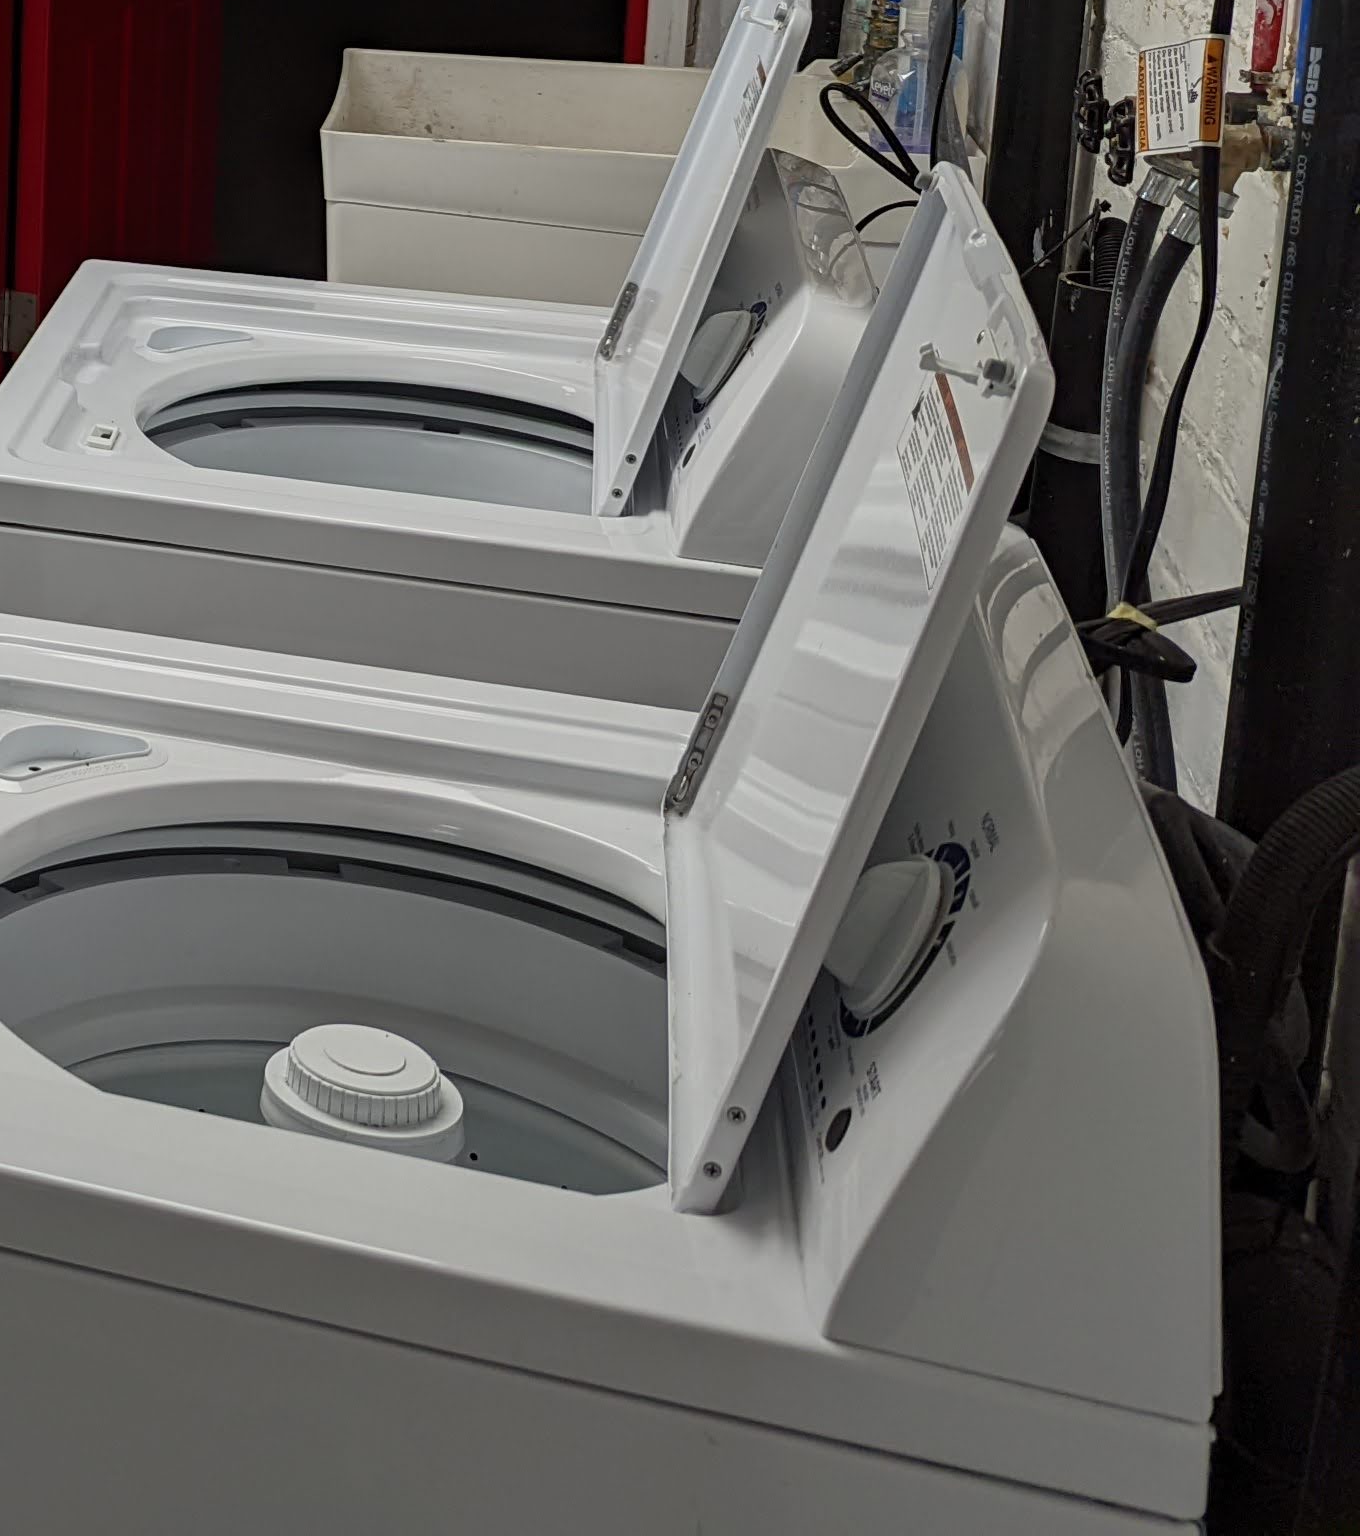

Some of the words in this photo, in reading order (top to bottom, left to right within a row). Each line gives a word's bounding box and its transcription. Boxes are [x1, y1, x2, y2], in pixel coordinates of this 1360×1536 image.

[1205, 66, 1217, 125] WARNING
[1289, 154, 1308, 236] COEXTRUDED
[1124, 227, 1137, 256] HOT
[1286, 241, 1297, 267] ABS
[1118, 258, 1130, 286] HOT
[1113, 289, 1124, 316] HOT
[1278, 272, 1294, 337] CELLULAR
[1107, 355, 1115, 382] HOT
[1275, 341, 1286, 373] COE
[1262, 410, 1278, 473] Schedule
